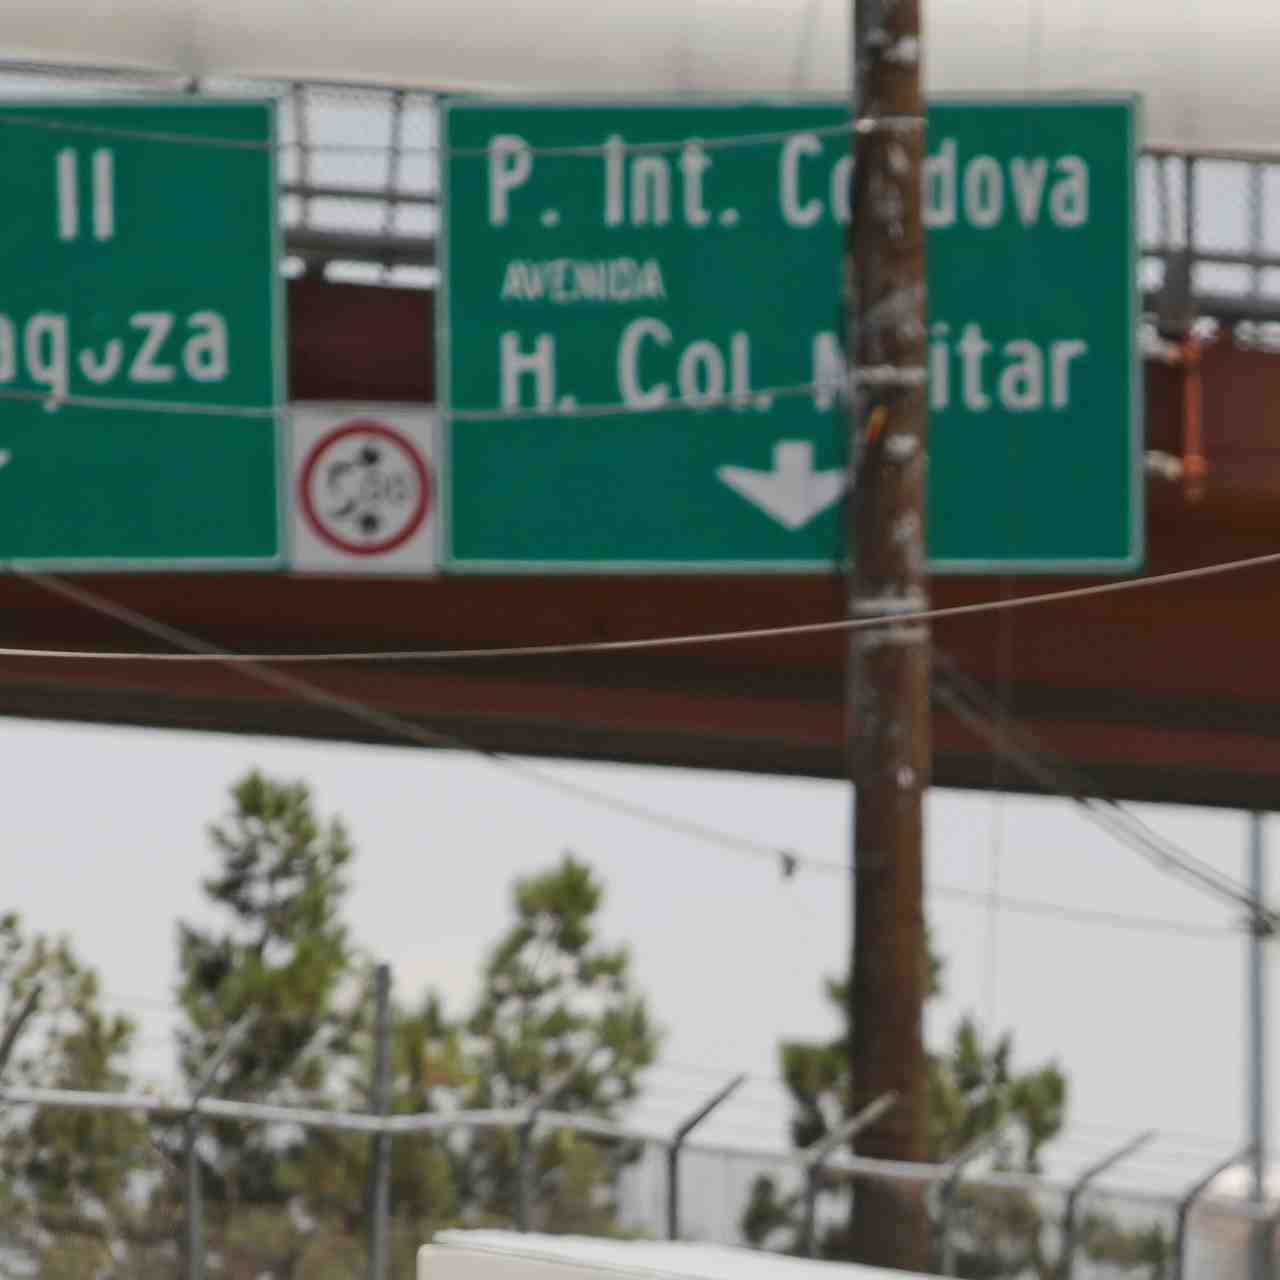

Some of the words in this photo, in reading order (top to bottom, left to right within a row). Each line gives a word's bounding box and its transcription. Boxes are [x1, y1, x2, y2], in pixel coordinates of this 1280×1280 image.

[56, 147, 116, 241] II
[488, 134, 561, 227] P.
[603, 134, 740, 227] Int.
[500, 258, 666, 301] AVENIDA
[499, 331, 577, 413] H.
[618, 317, 774, 411] Col.
[812, 321, 1088, 412] Mitar
